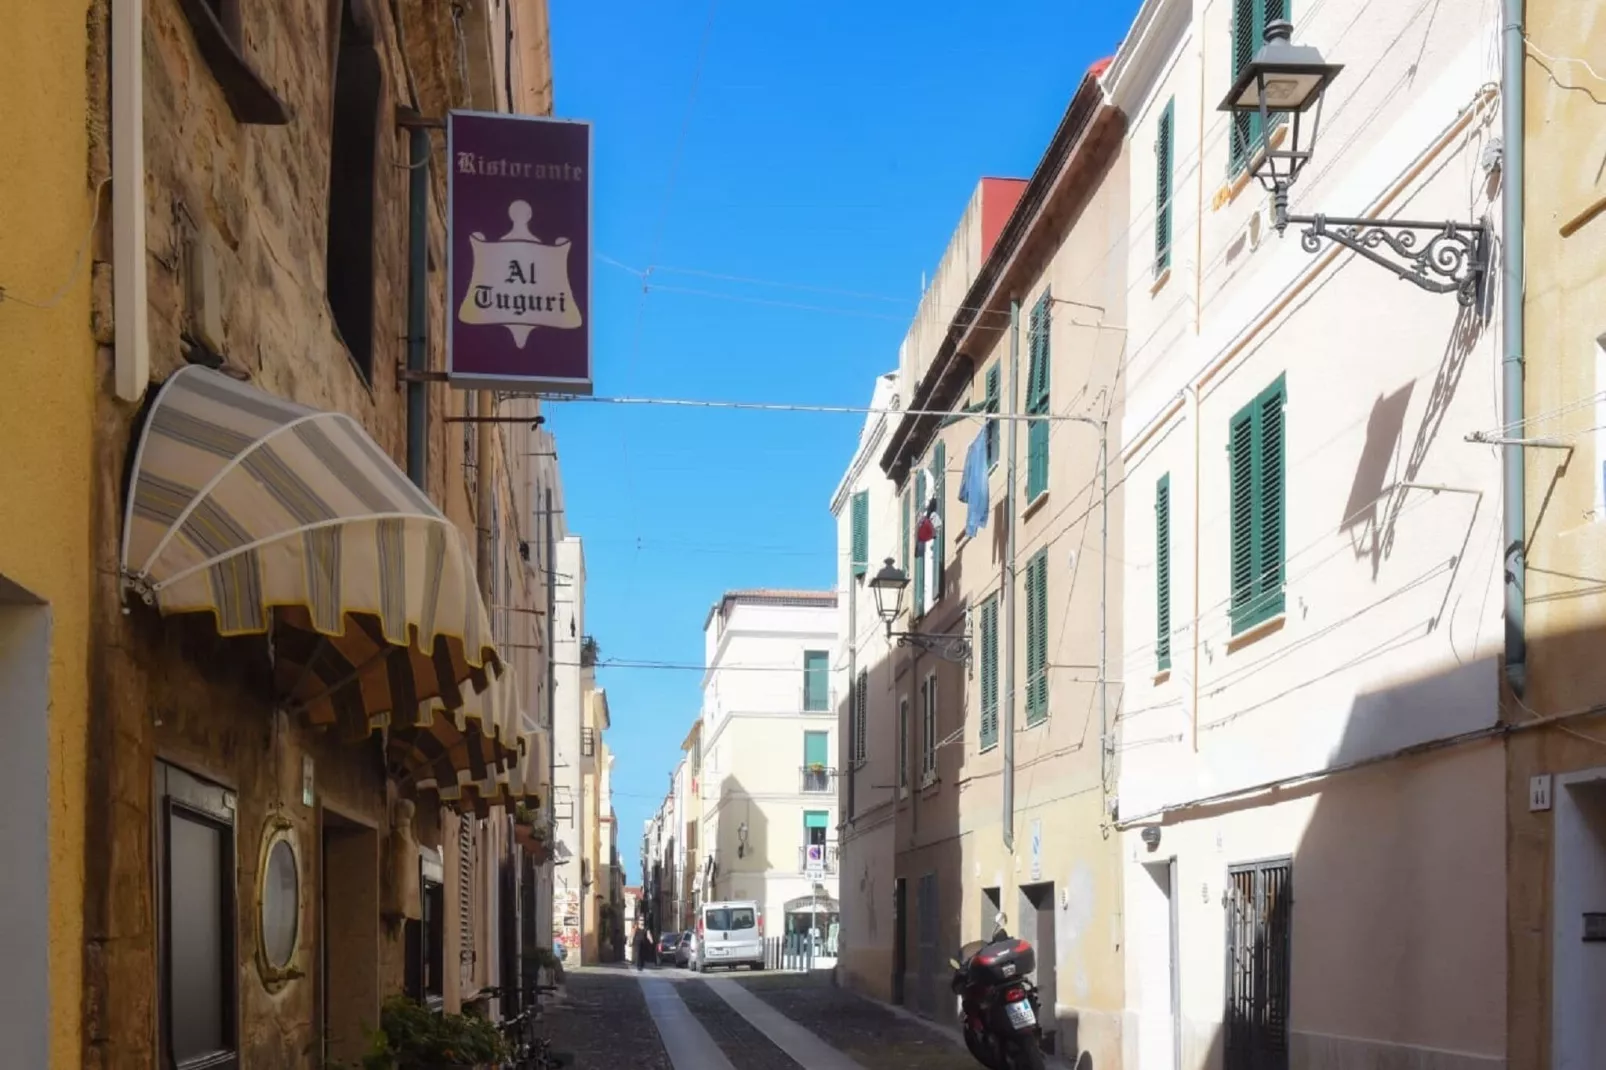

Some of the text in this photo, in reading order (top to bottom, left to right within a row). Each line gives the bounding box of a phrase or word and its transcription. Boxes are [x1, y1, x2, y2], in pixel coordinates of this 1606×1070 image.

[457, 151, 583, 181] Ristorante
[505, 259, 537, 284] Al
[474, 285, 567, 316] Tuguri
